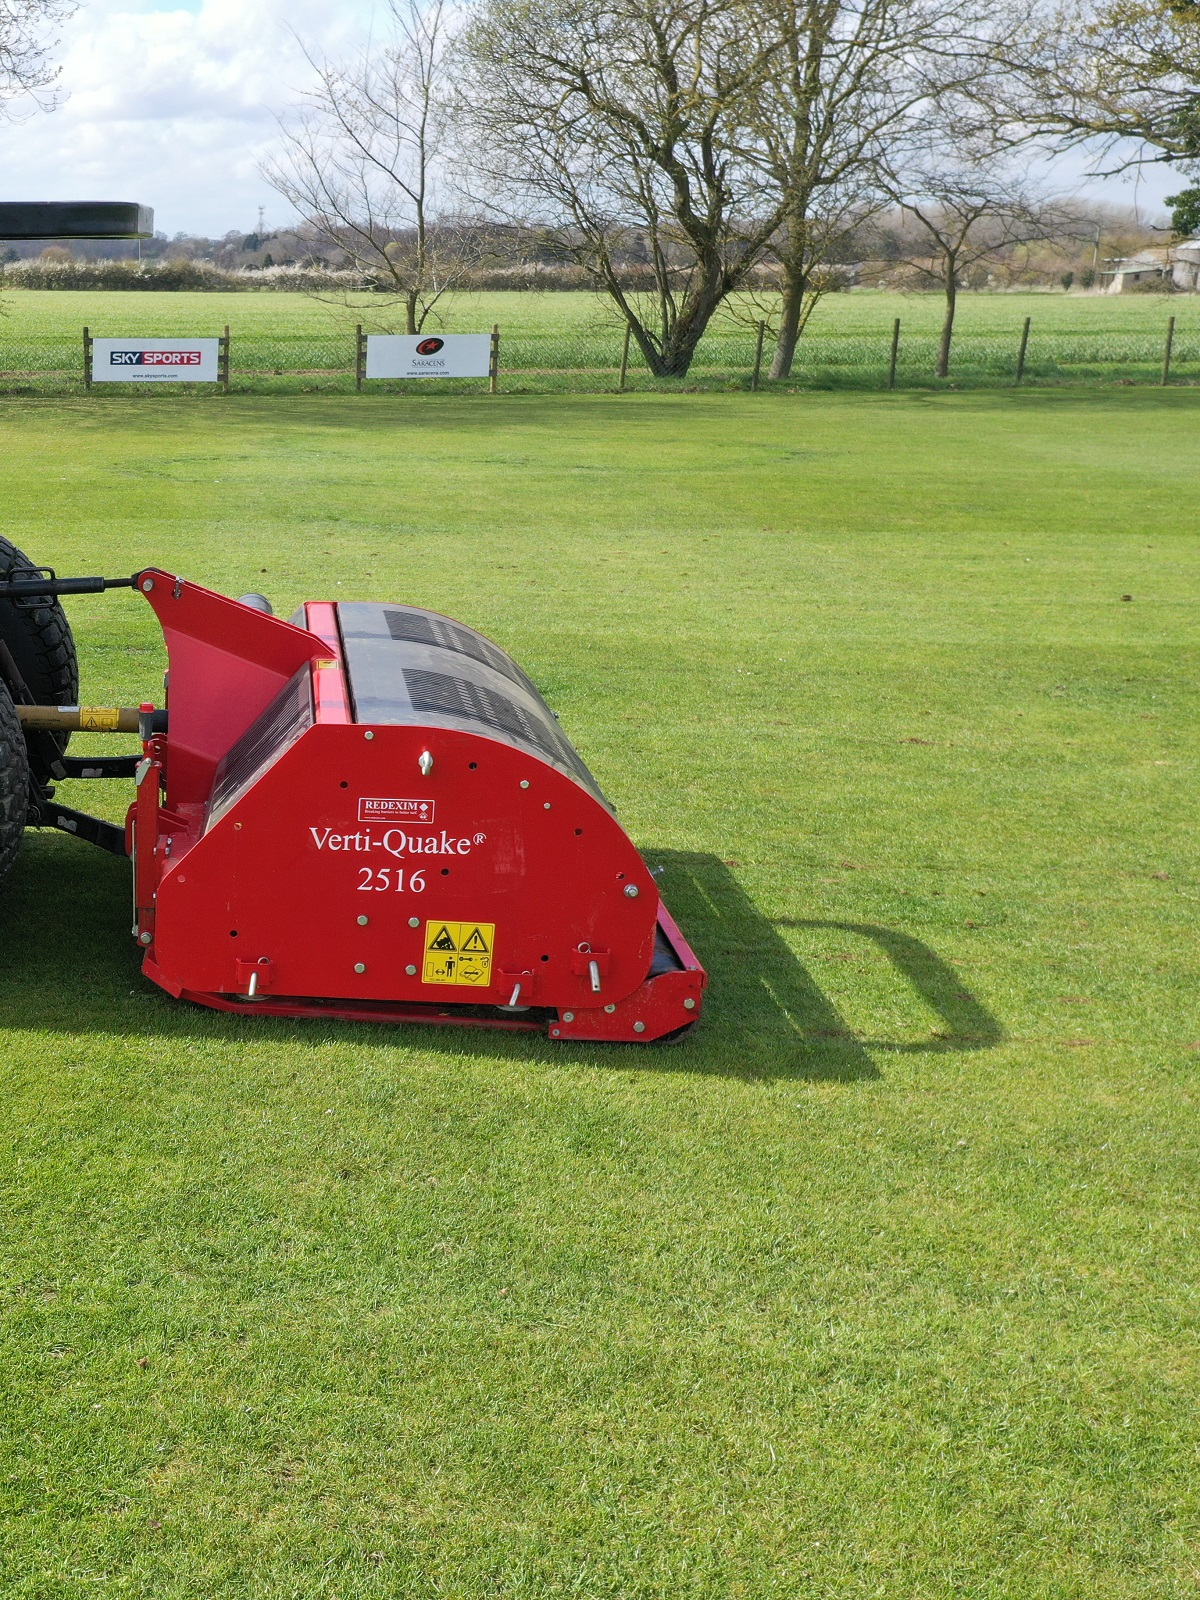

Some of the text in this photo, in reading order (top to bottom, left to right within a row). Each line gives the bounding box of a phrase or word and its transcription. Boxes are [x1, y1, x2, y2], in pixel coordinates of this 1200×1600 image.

[112, 353, 200, 364] SKY SPORTS
[412, 359, 446, 367] SARACENS
[365, 800, 418, 811] REDEXIM
[356, 867, 426, 893] 2516
